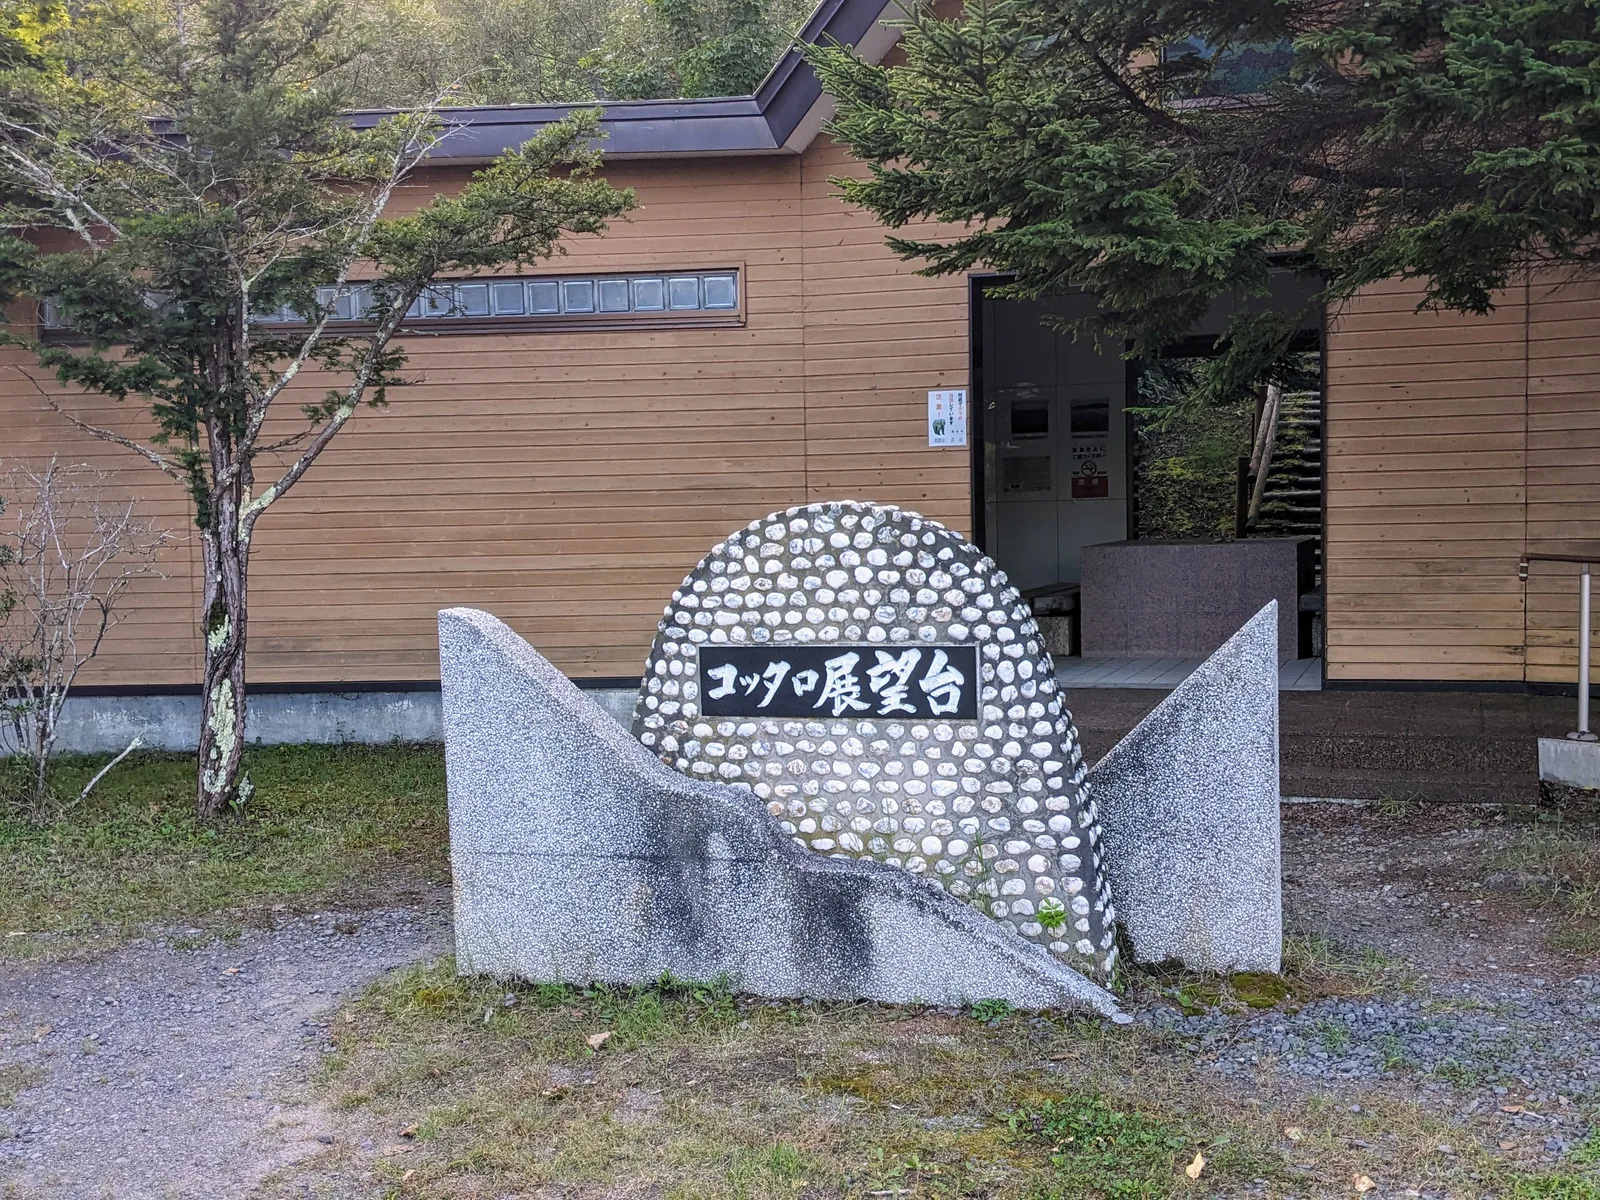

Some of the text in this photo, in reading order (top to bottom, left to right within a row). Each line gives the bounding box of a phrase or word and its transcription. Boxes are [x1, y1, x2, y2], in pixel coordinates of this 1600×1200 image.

[707, 648, 965, 717] コッタロ展望台
